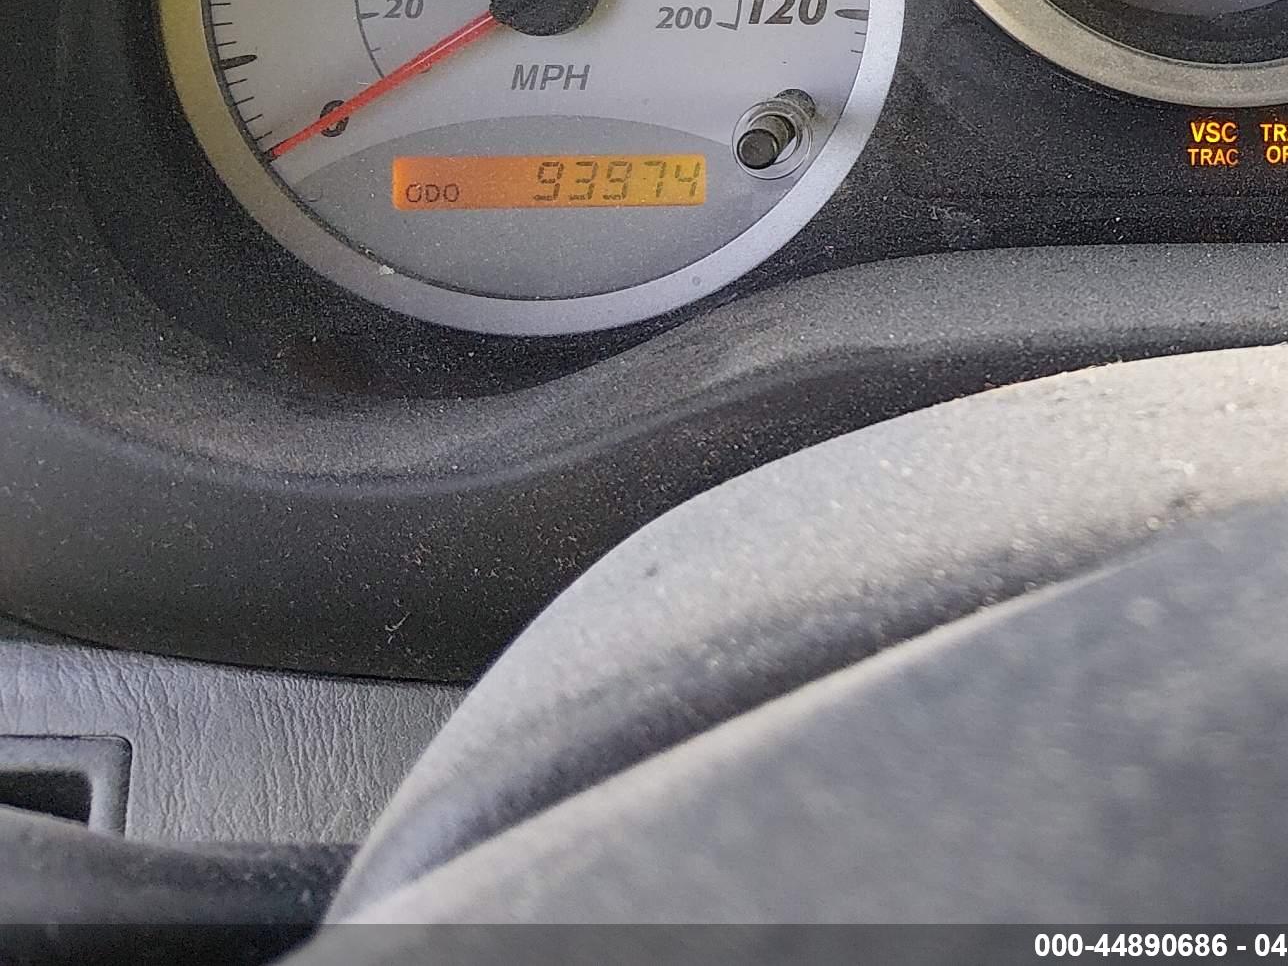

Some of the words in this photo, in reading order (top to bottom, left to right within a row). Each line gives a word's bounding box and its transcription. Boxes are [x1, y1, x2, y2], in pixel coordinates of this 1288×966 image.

[655, 6, 713, 30] 200
[510, 63, 591, 91] MPH
[1189, 122, 1238, 143] VSC
[1187, 147, 1239, 166] TRAC
[533, 160, 702, 202] 93974
[405, 183, 460, 204] ODO
